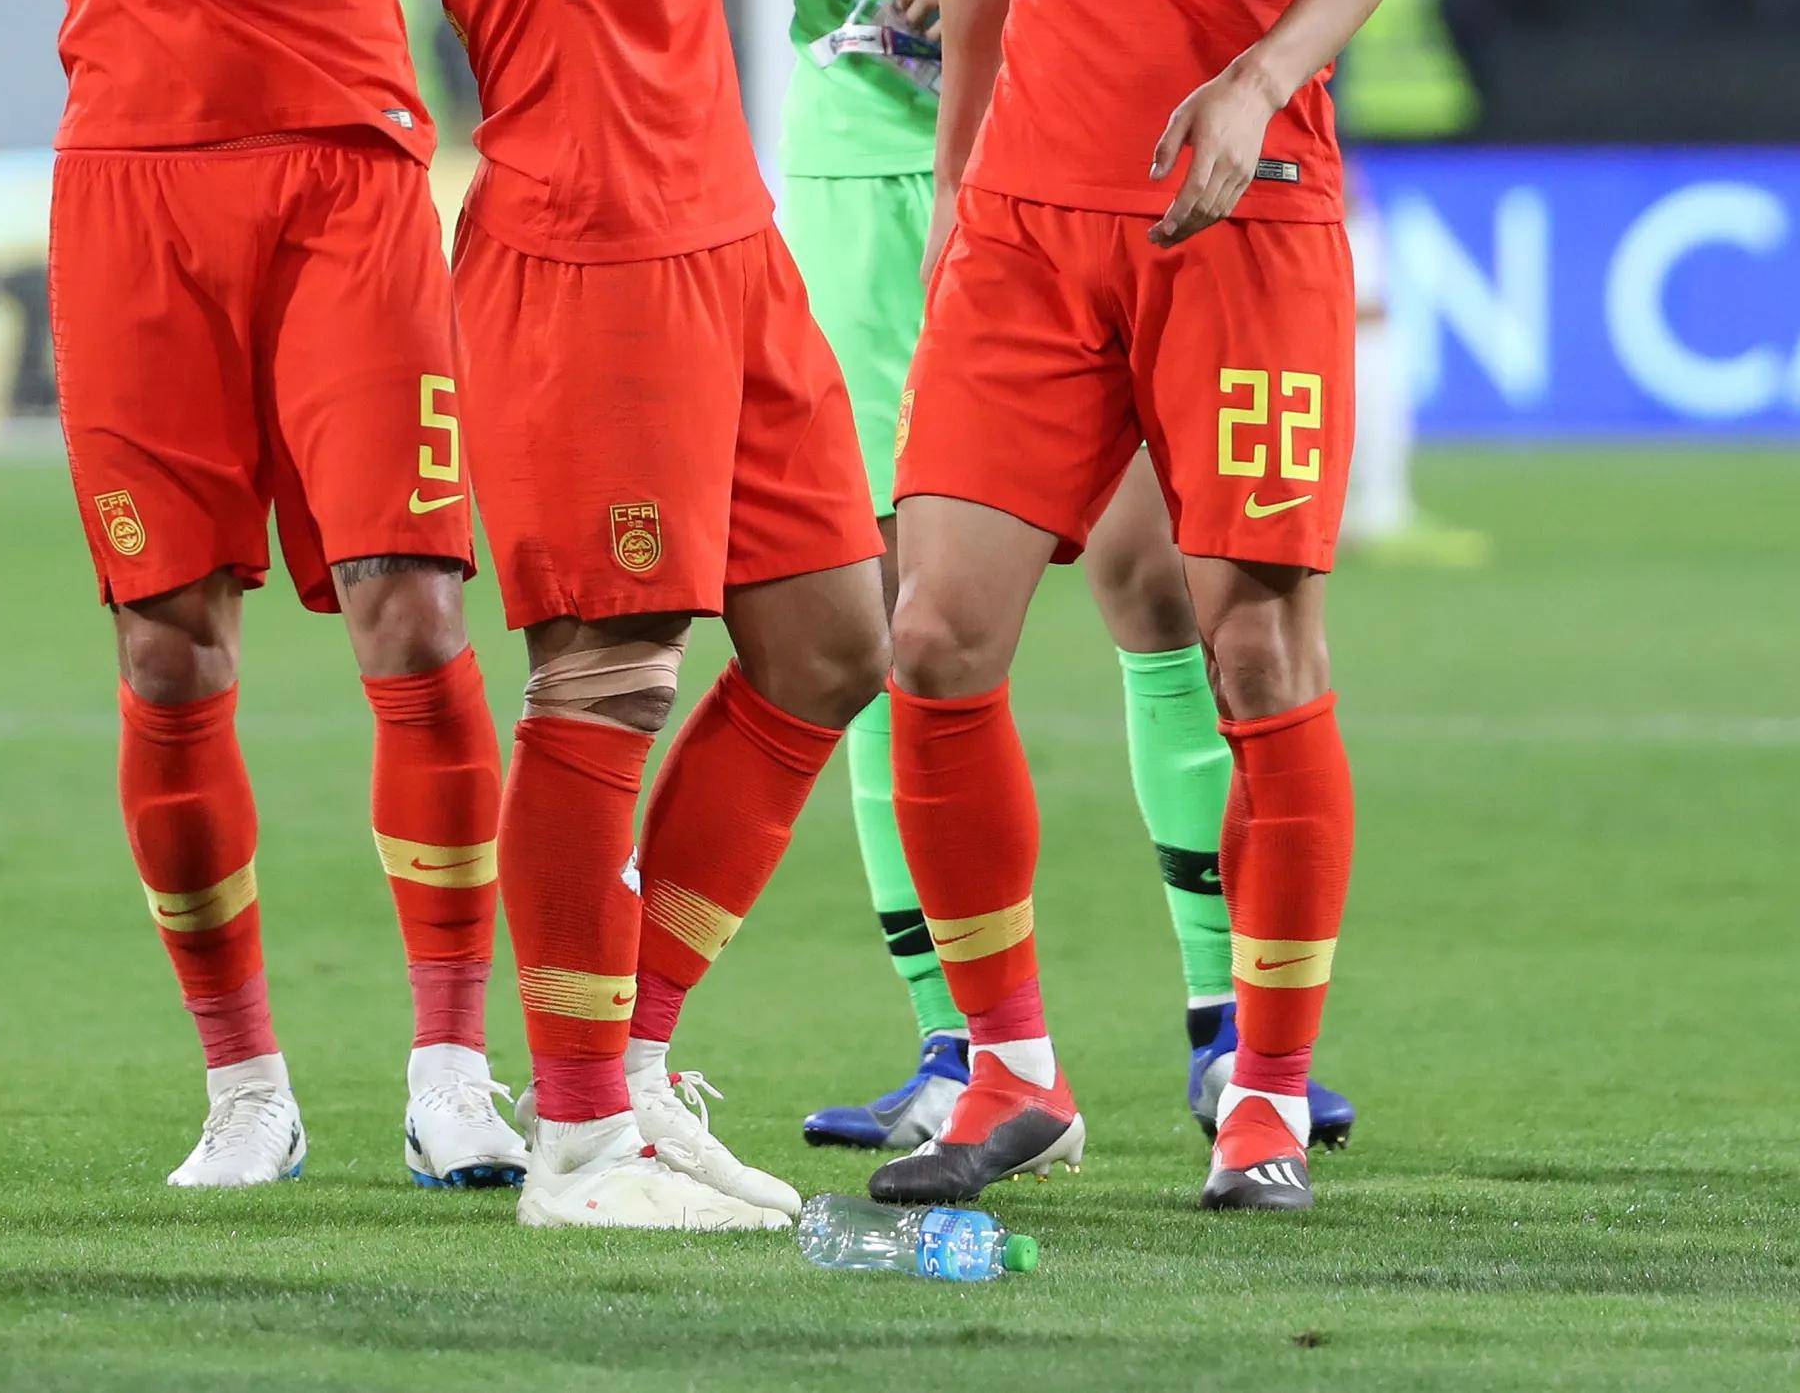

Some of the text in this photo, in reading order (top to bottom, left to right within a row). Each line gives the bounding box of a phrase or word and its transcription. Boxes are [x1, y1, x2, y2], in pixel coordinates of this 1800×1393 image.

[1604, 180, 1800, 419] C
[418, 374, 460, 483] 5
[1218, 367, 1322, 483] 22
[99, 494, 130, 511] CFA
[614, 507, 655, 522] CFA
